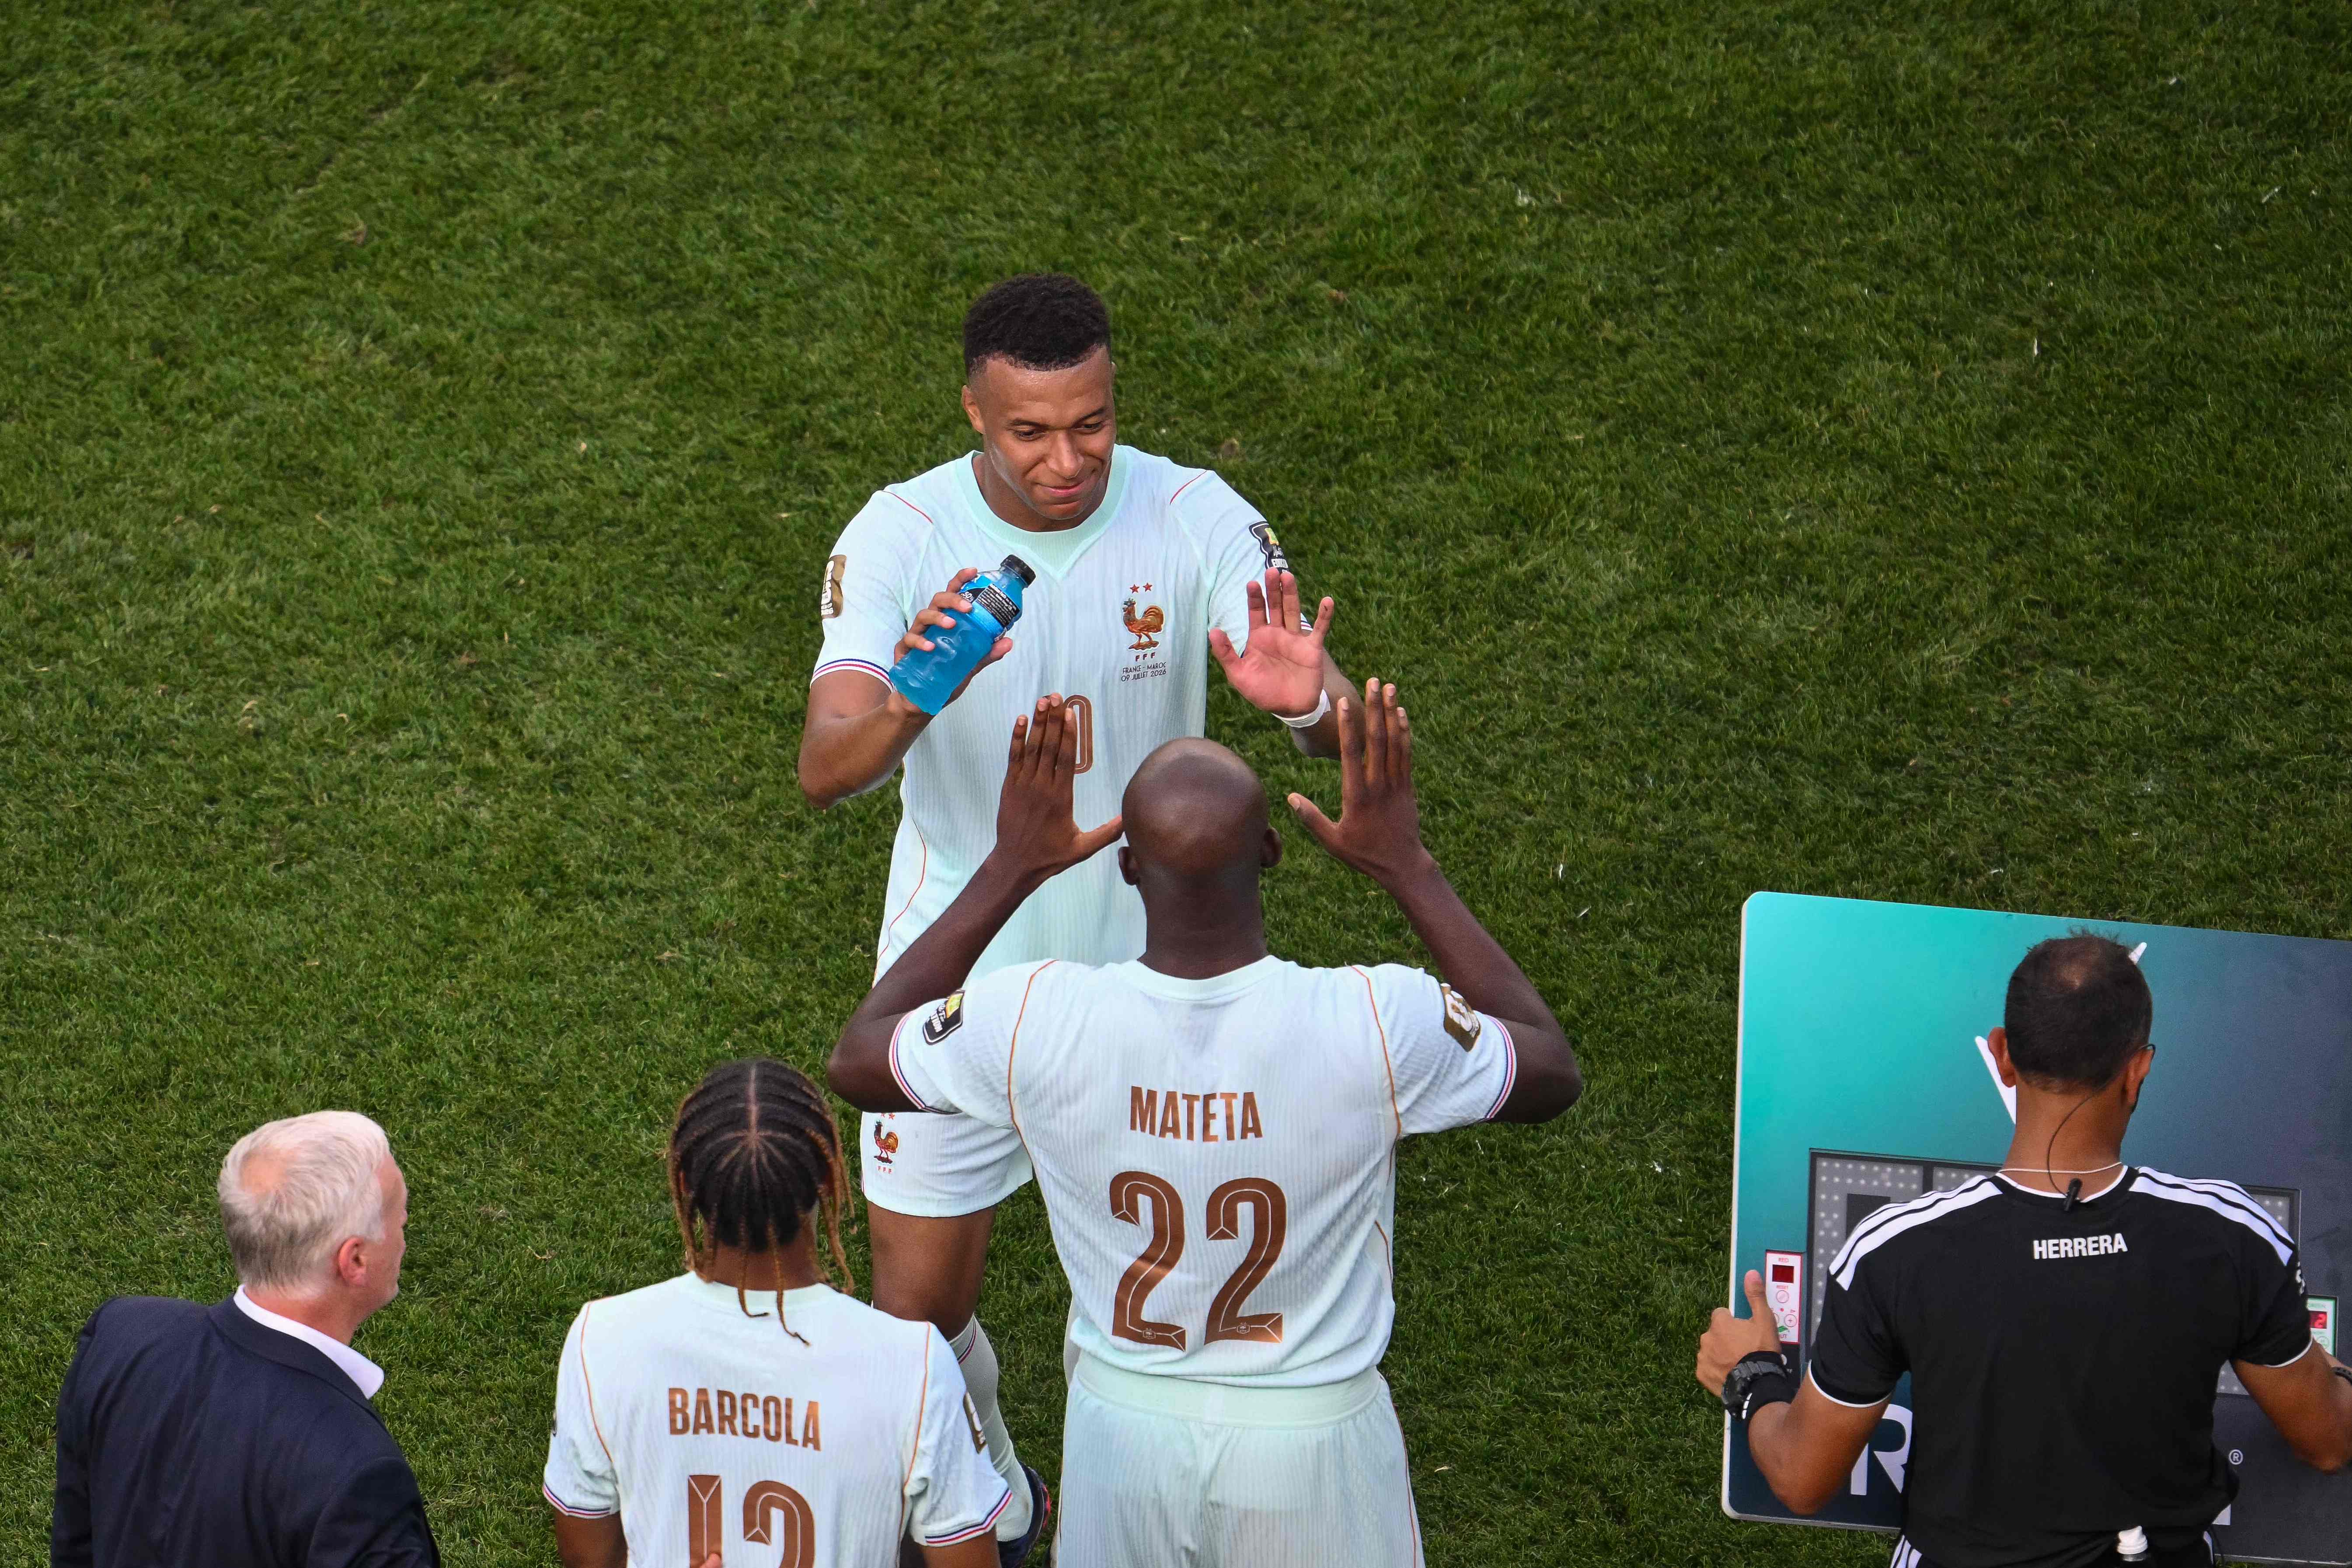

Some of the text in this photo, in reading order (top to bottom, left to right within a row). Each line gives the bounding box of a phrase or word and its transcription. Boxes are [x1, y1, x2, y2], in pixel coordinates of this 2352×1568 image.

[1121, 669, 1166, 682] 09 JUILLET 2026
[1122, 665, 1141, 674] FRANCE
[1147, 662, 1166, 670] MAROC
[1130, 1085, 1263, 1142] MATETA
[1109, 1171, 1287, 1352] 22
[2033, 1233, 2128, 1259] HERRERA
[669, 1387, 821, 1452] BARCOLA
